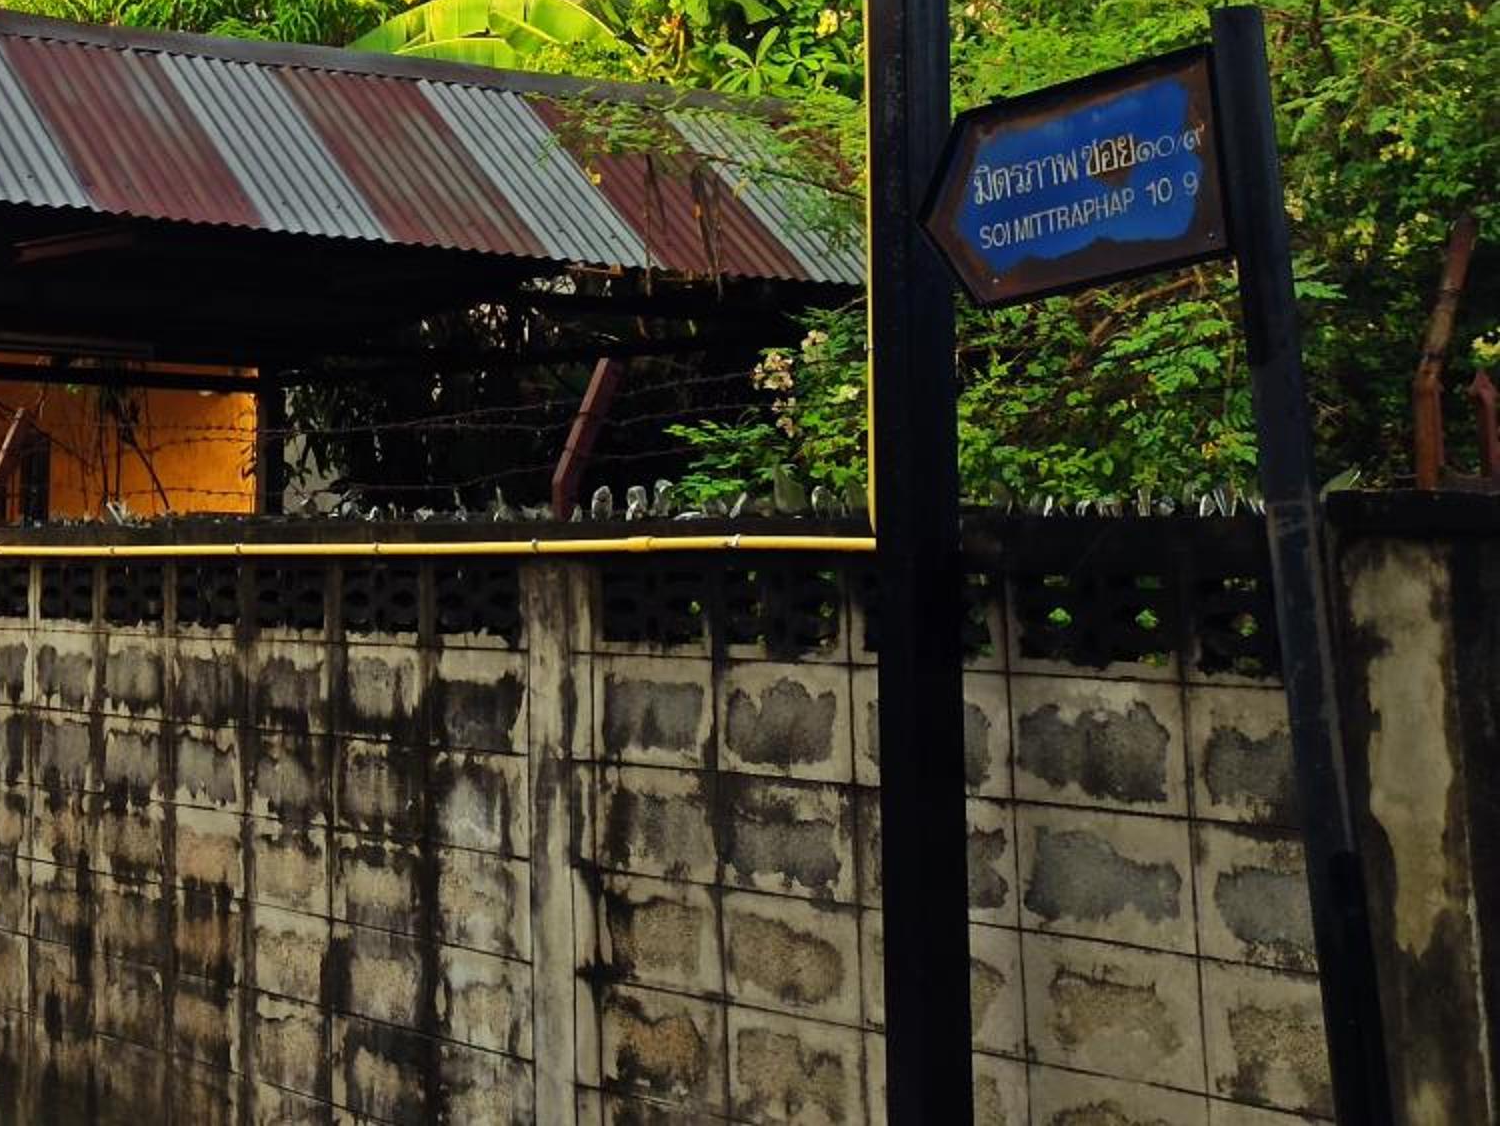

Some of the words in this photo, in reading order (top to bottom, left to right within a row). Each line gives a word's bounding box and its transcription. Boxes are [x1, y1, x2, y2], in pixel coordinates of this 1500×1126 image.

[973, 149, 1079, 205] มิตรภาพ
[979, 221, 1011, 250] SOI
[1015, 187, 1135, 243] MITTRAPHAP
